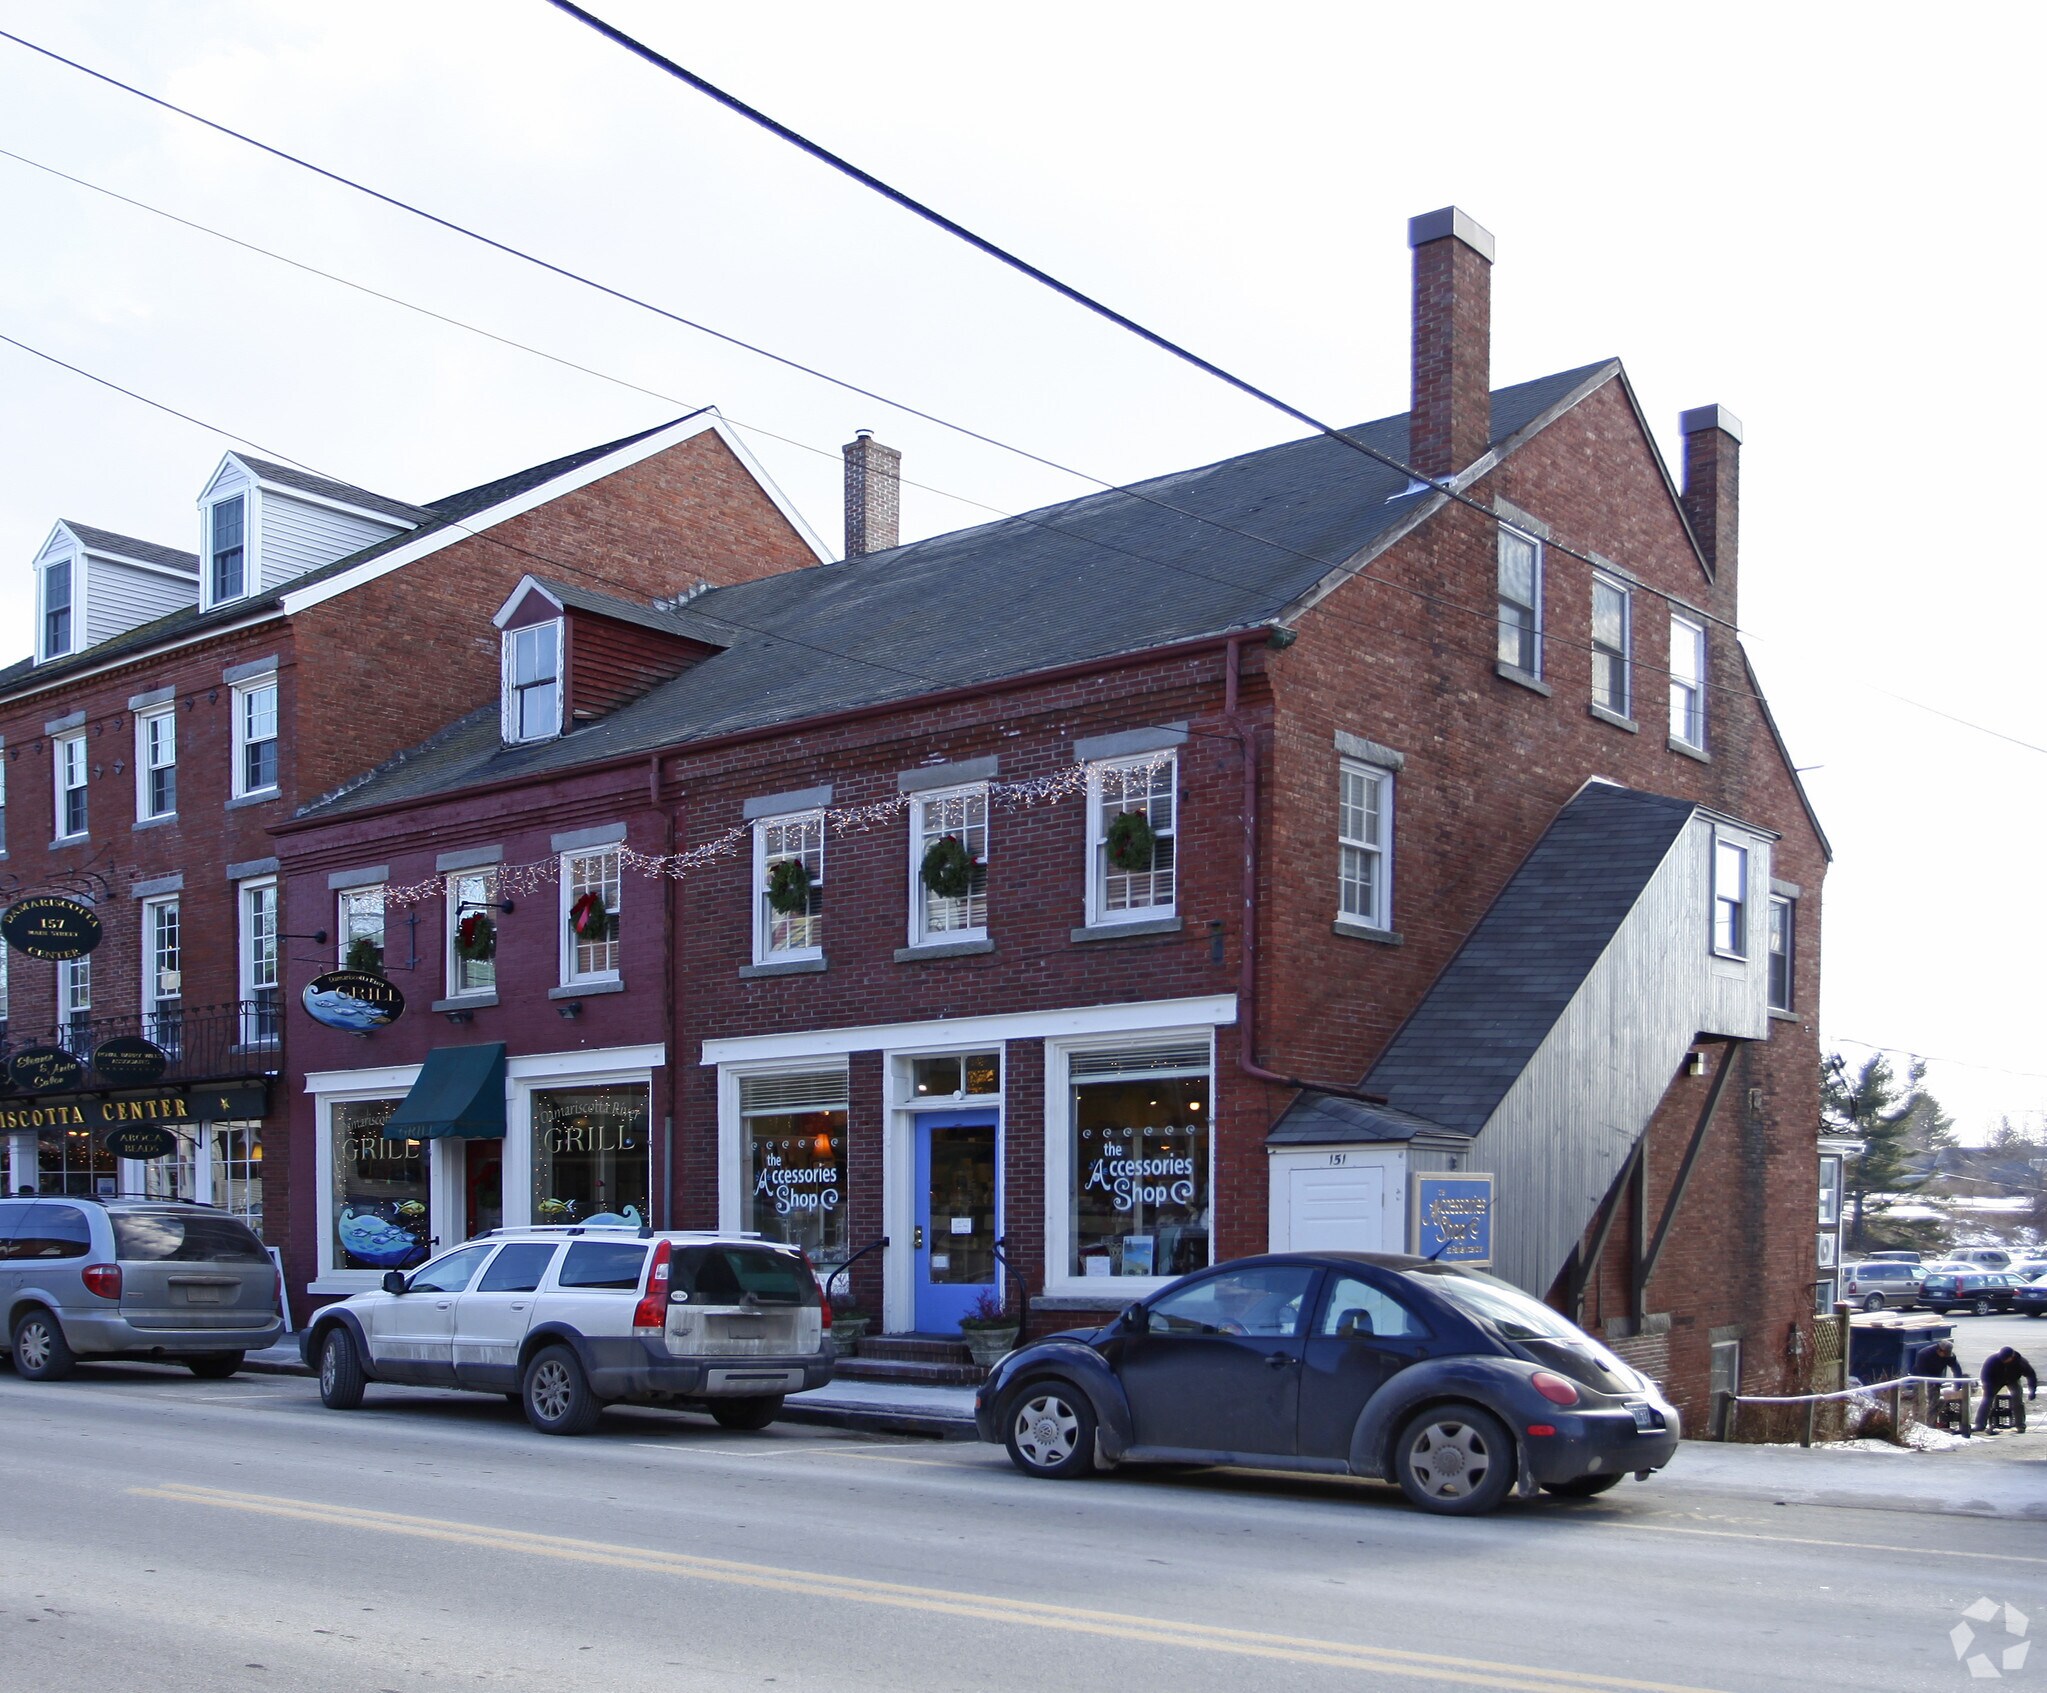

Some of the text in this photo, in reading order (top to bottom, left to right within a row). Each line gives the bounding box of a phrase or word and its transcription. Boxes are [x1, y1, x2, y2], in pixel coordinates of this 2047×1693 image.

[4, 899, 99, 928] DAMARISCOTTA
[41, 918, 65, 929] 157
[27, 946, 81, 959] CENTER
[335, 985, 400, 1001] GRILL
[102, 1098, 188, 1121] CENTER
[343, 1137, 419, 1161] GRILL
[543, 1124, 636, 1154] GRILL
[1103, 1141, 1122, 1157] the
[766, 1152, 782, 1166] the
[1329, 1153, 1346, 1166] 151
[753, 1162, 837, 1197] Accessories
[1084, 1152, 1193, 1191] Accessories
[775, 1184, 819, 1214] Shop
[1113, 1177, 1167, 1211] Shop
